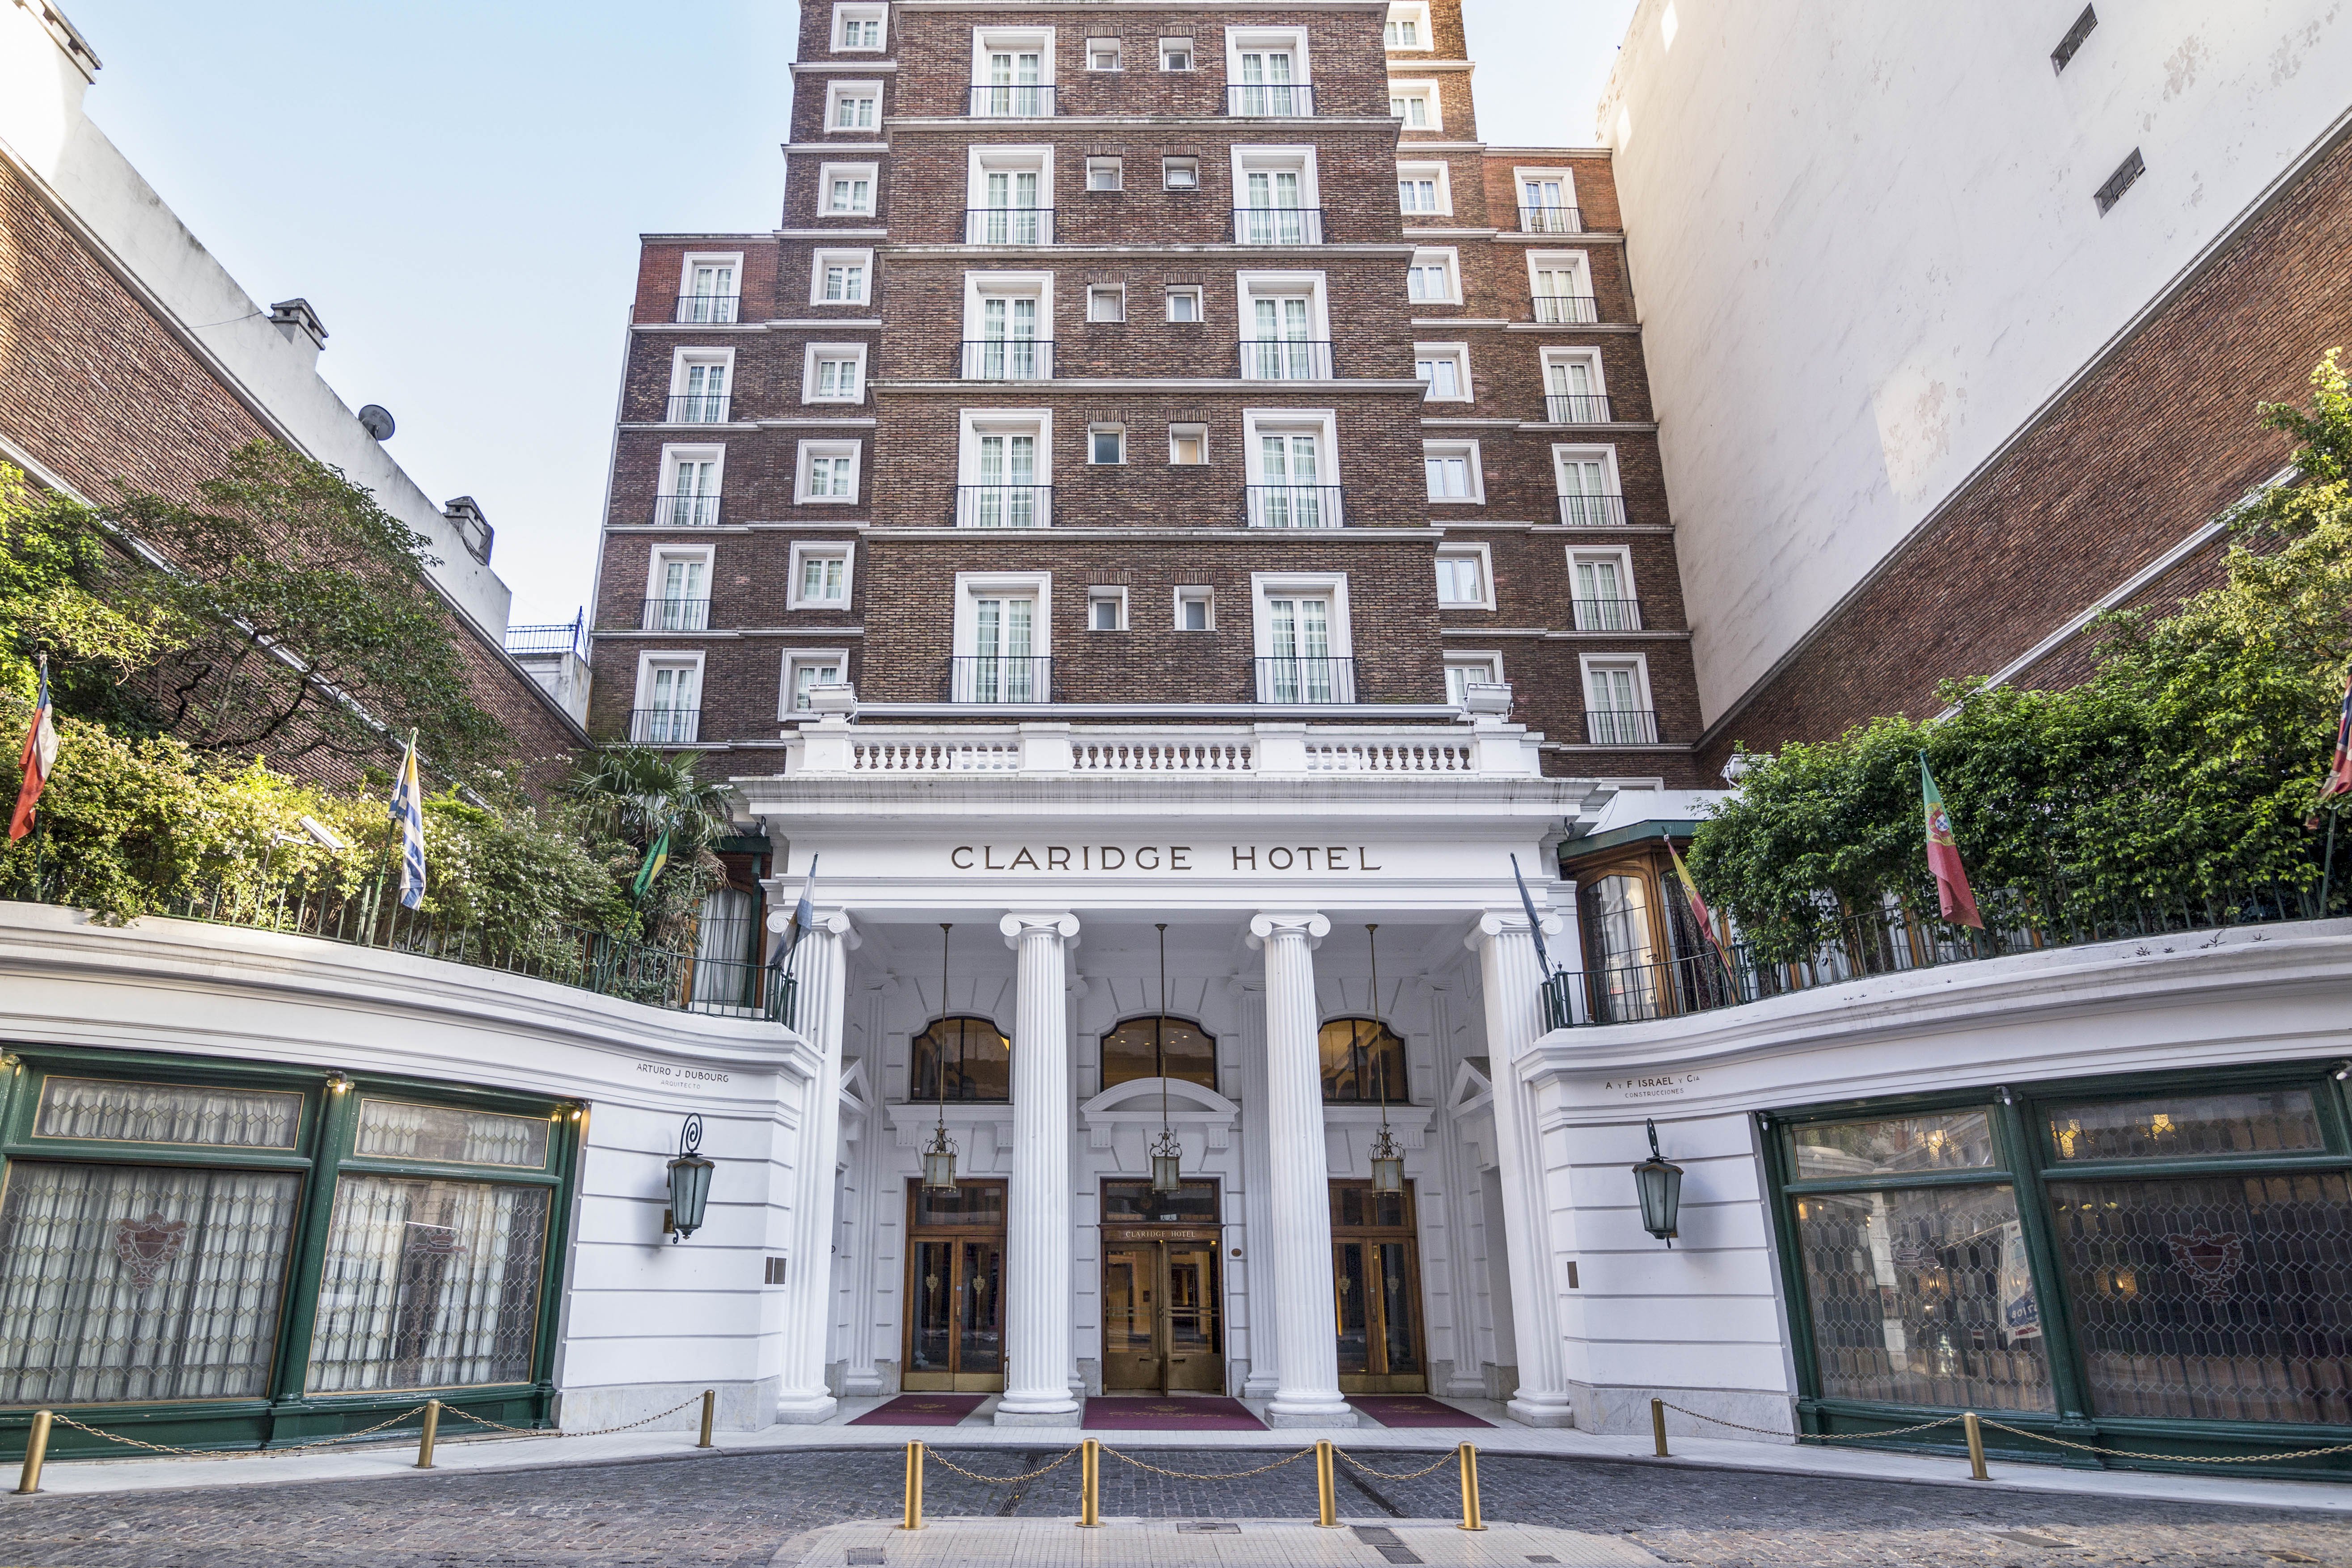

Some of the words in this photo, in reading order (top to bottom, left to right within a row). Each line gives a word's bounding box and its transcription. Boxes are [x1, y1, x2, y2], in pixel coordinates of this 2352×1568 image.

[951, 845, 1193, 871] CLARIDGE
[1231, 845, 1383, 871] HOTEL
[637, 1064, 671, 1075] ARTURO
[685, 1070, 729, 1082] DUBOURG
[661, 1080, 701, 1090] ARQUITECTO
[1627, 1080, 1632, 1088] F
[1638, 1077, 1674, 1087] ISRAEL
[1625, 1088, 1684, 1098] CONSTRUCCIONES
